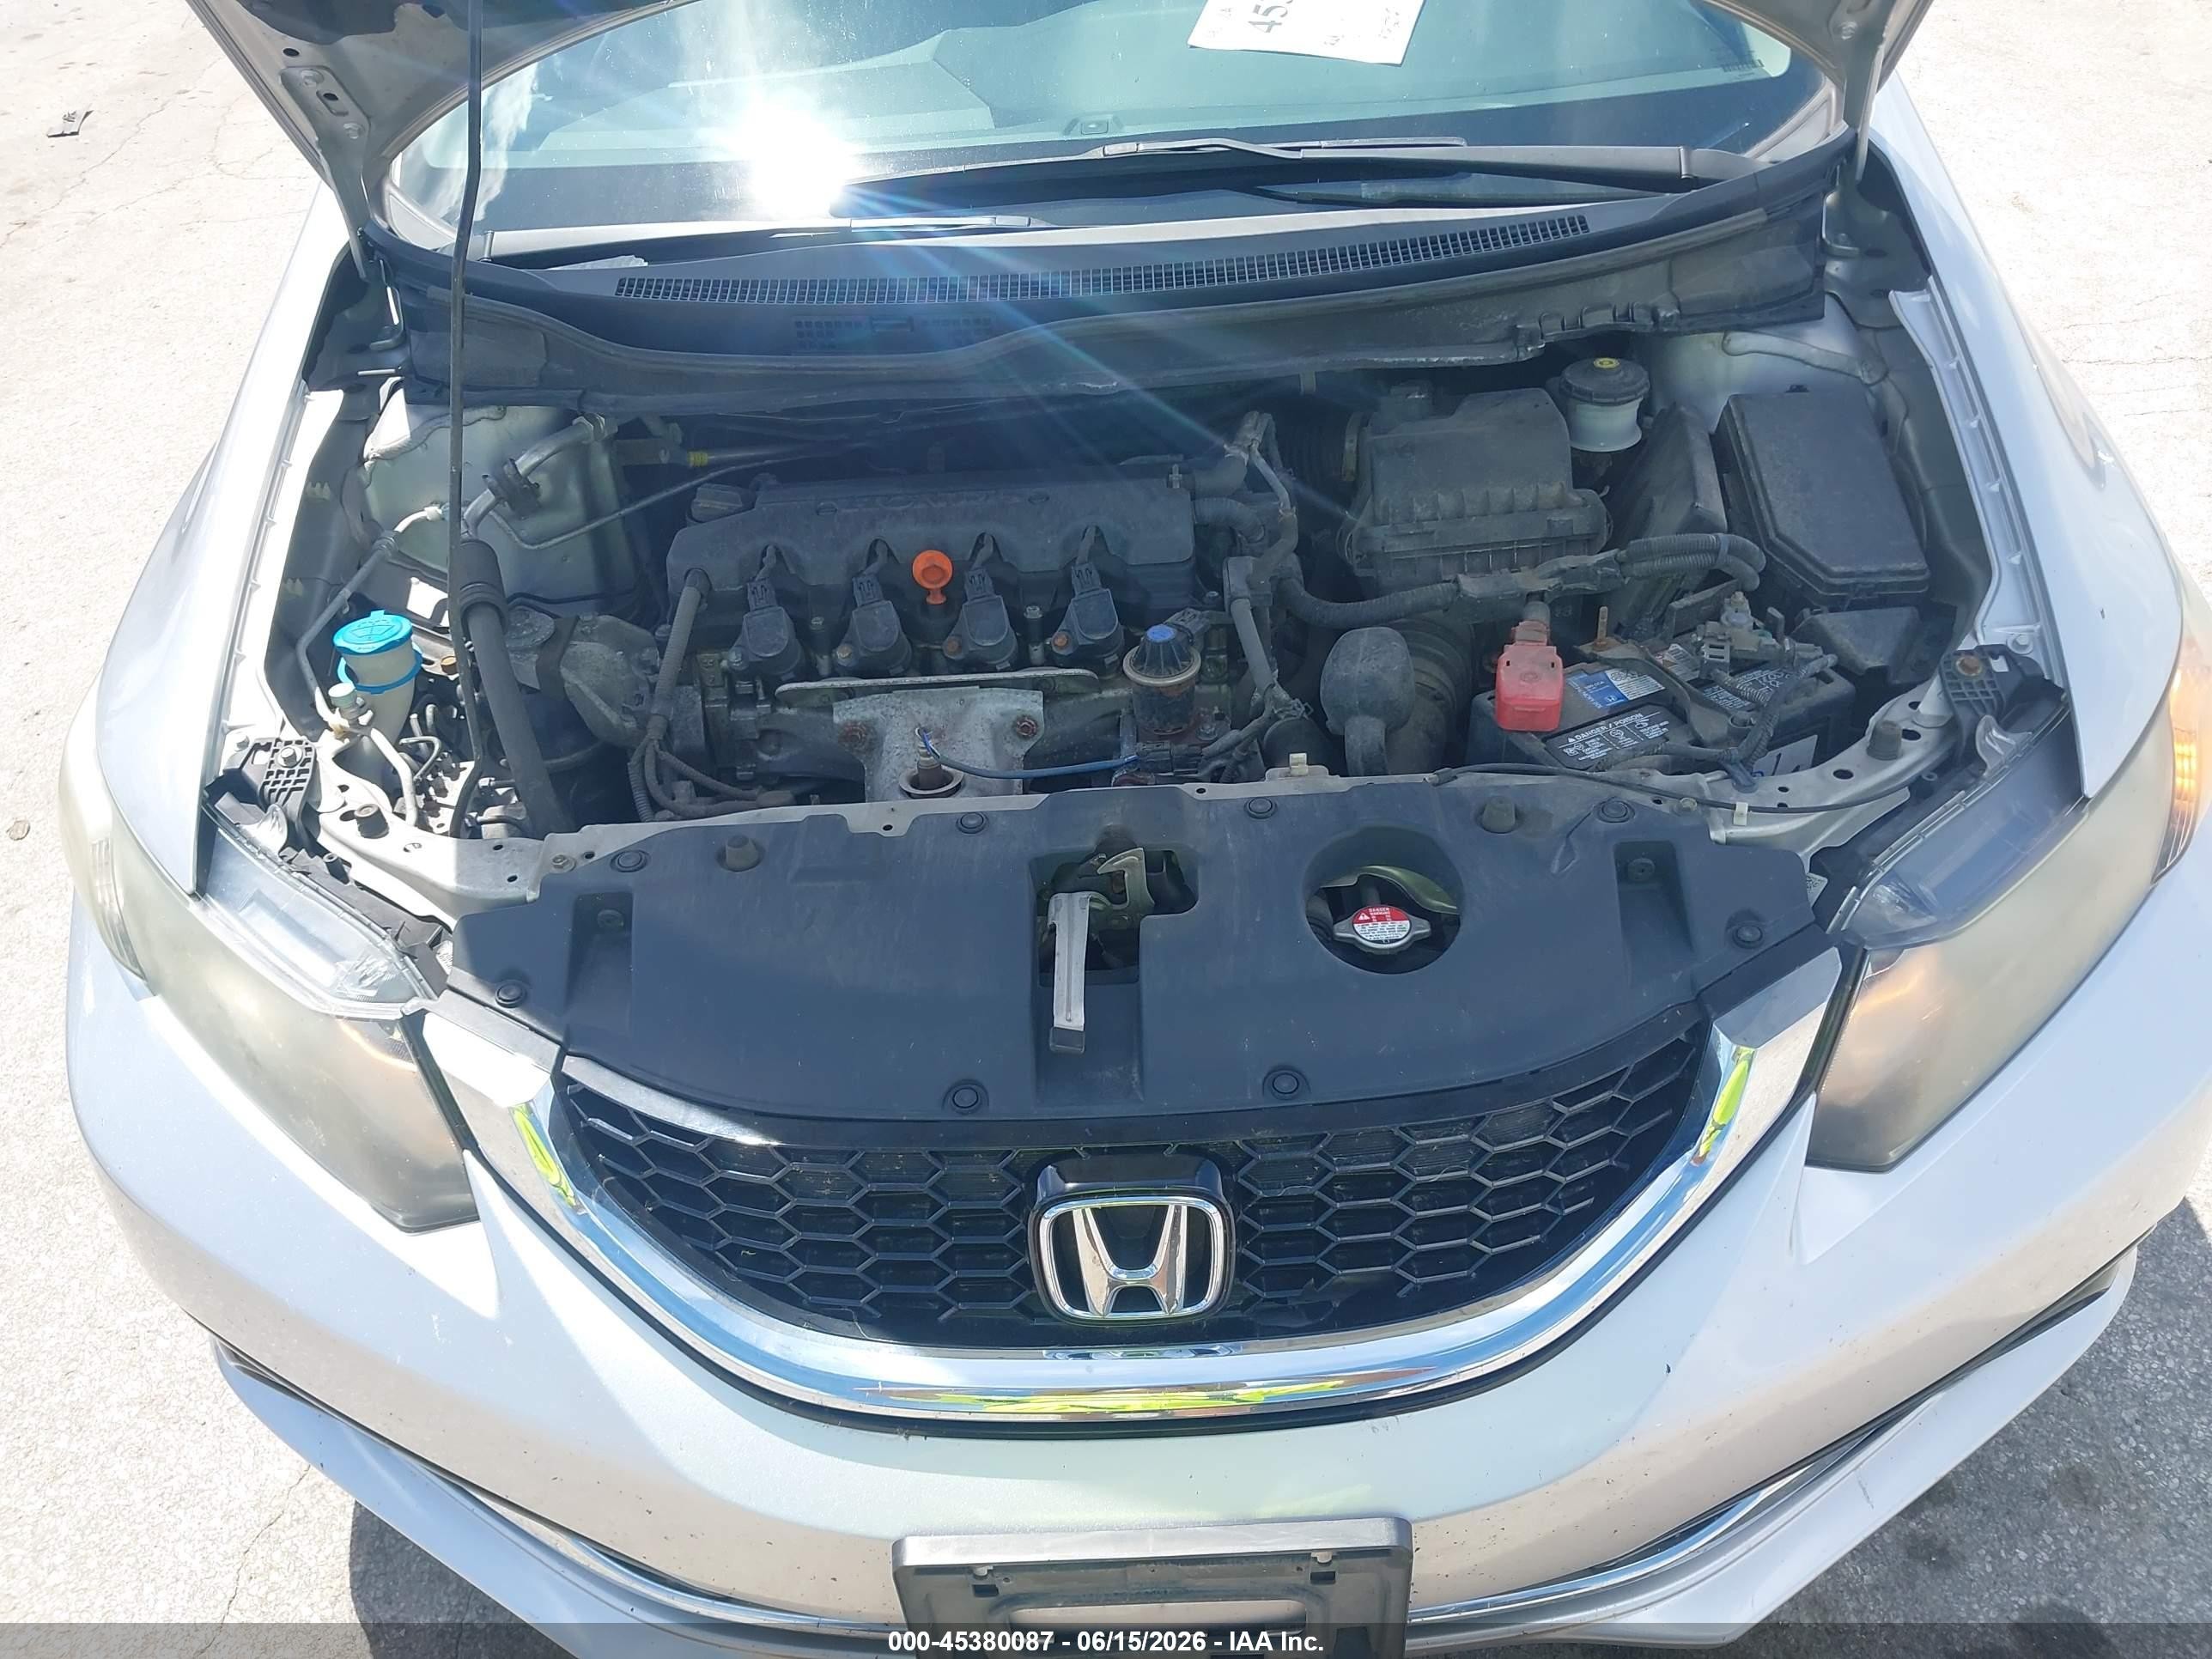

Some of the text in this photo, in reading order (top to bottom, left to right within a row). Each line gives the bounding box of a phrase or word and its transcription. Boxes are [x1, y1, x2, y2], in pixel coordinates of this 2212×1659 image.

[1248, 0, 1294, 33] 45
[1574, 726, 1608, 740] DANGER
[1613, 713, 1644, 726] POISON
